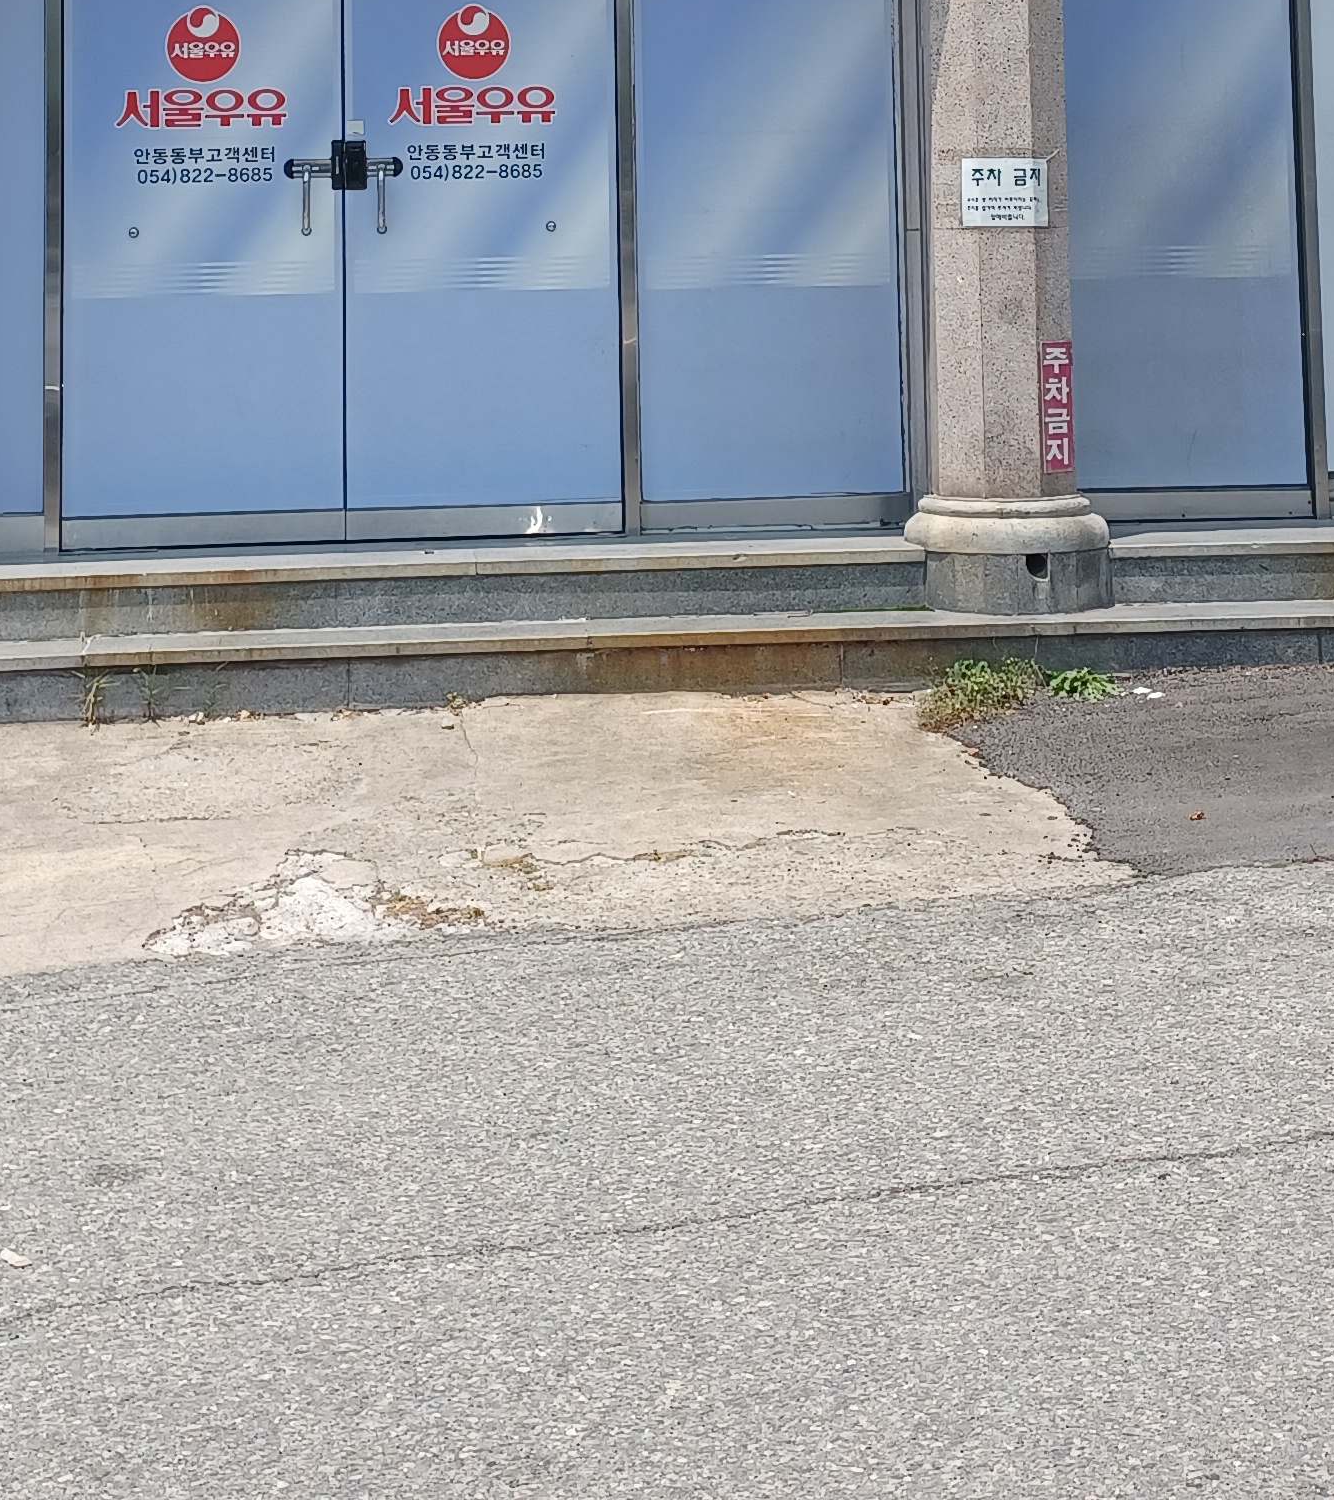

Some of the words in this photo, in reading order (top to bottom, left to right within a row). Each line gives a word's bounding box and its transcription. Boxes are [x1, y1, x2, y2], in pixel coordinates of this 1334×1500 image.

[170, 41, 236, 60] 서울우유
[441, 38, 506, 57] 서울우유
[115, 87, 288, 129] 서울우유
[388, 85, 557, 126] 서울우유
[137, 166, 274, 186] 054)822-8685
[410, 163, 543, 183] 054)822-8685
[971, 168, 1002, 187] 주차
[1013, 168, 1041, 187] 금지
[1043, 346, 1071, 467] 주차금지
